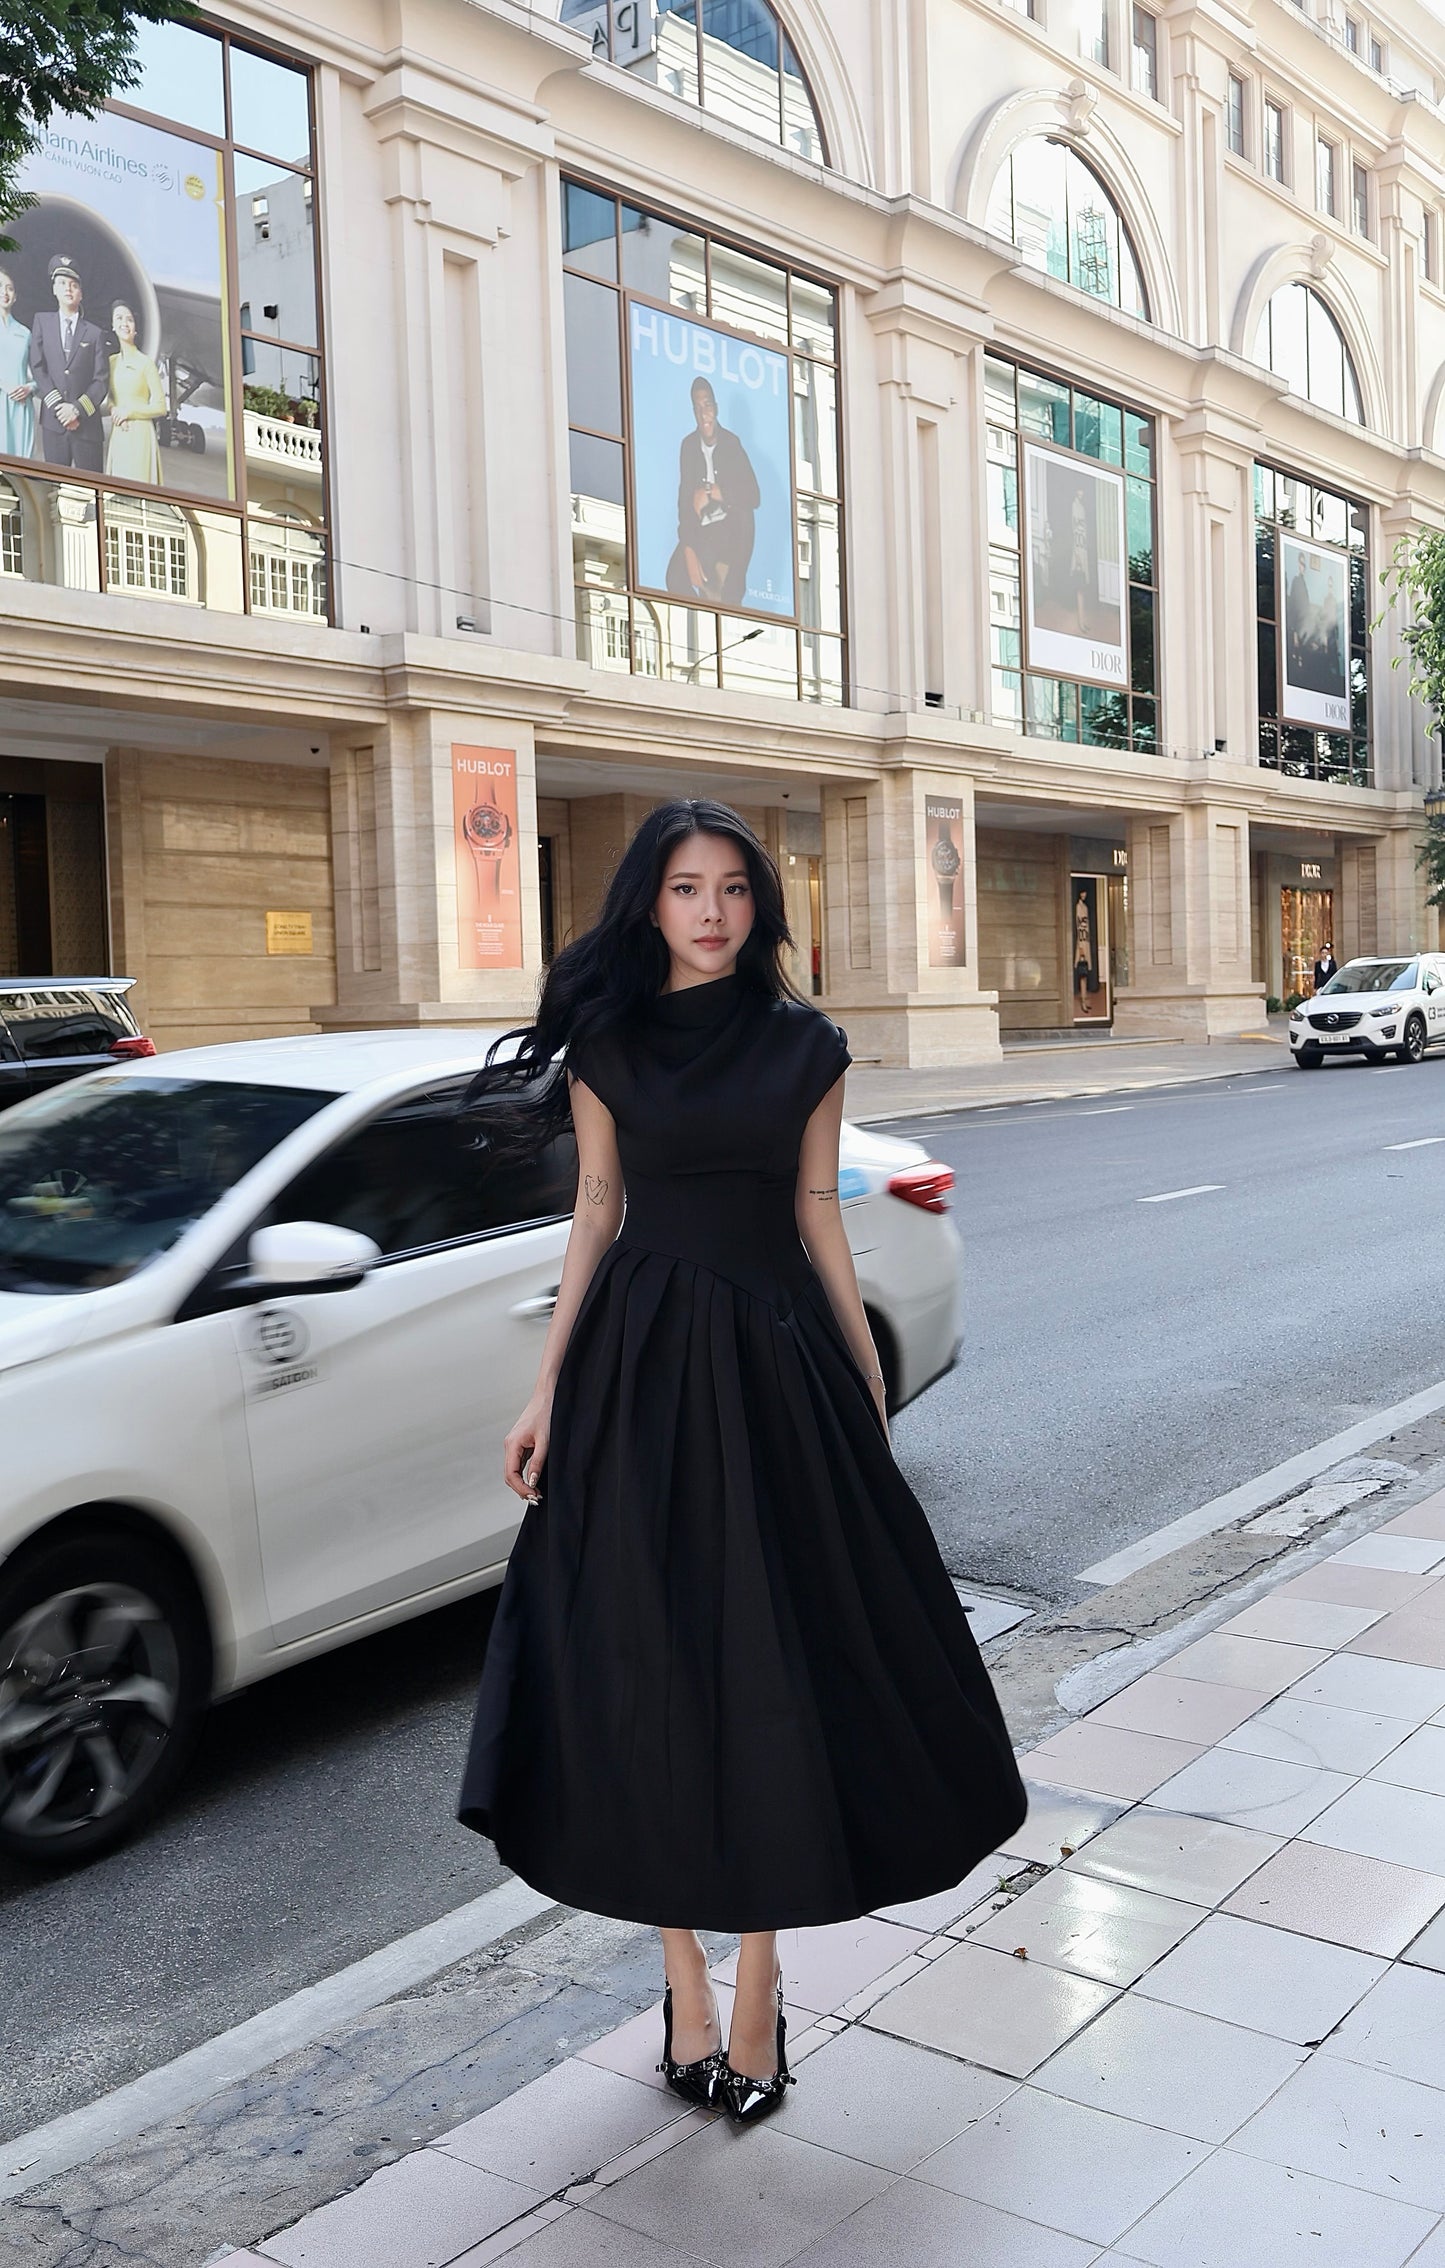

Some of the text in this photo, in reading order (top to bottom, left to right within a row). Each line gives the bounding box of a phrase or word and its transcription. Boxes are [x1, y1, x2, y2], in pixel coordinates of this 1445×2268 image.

[80, 139, 148, 178] Airlines
[632, 308, 785, 396] HUBLOT
[1091, 650, 1122, 674] DIOR
[1325, 702, 1347, 721] DIOR
[457, 758, 512, 777] HUBLOT
[927, 806, 960, 820] HUBLOT
[272, 1367, 318, 1390] SAIGON
